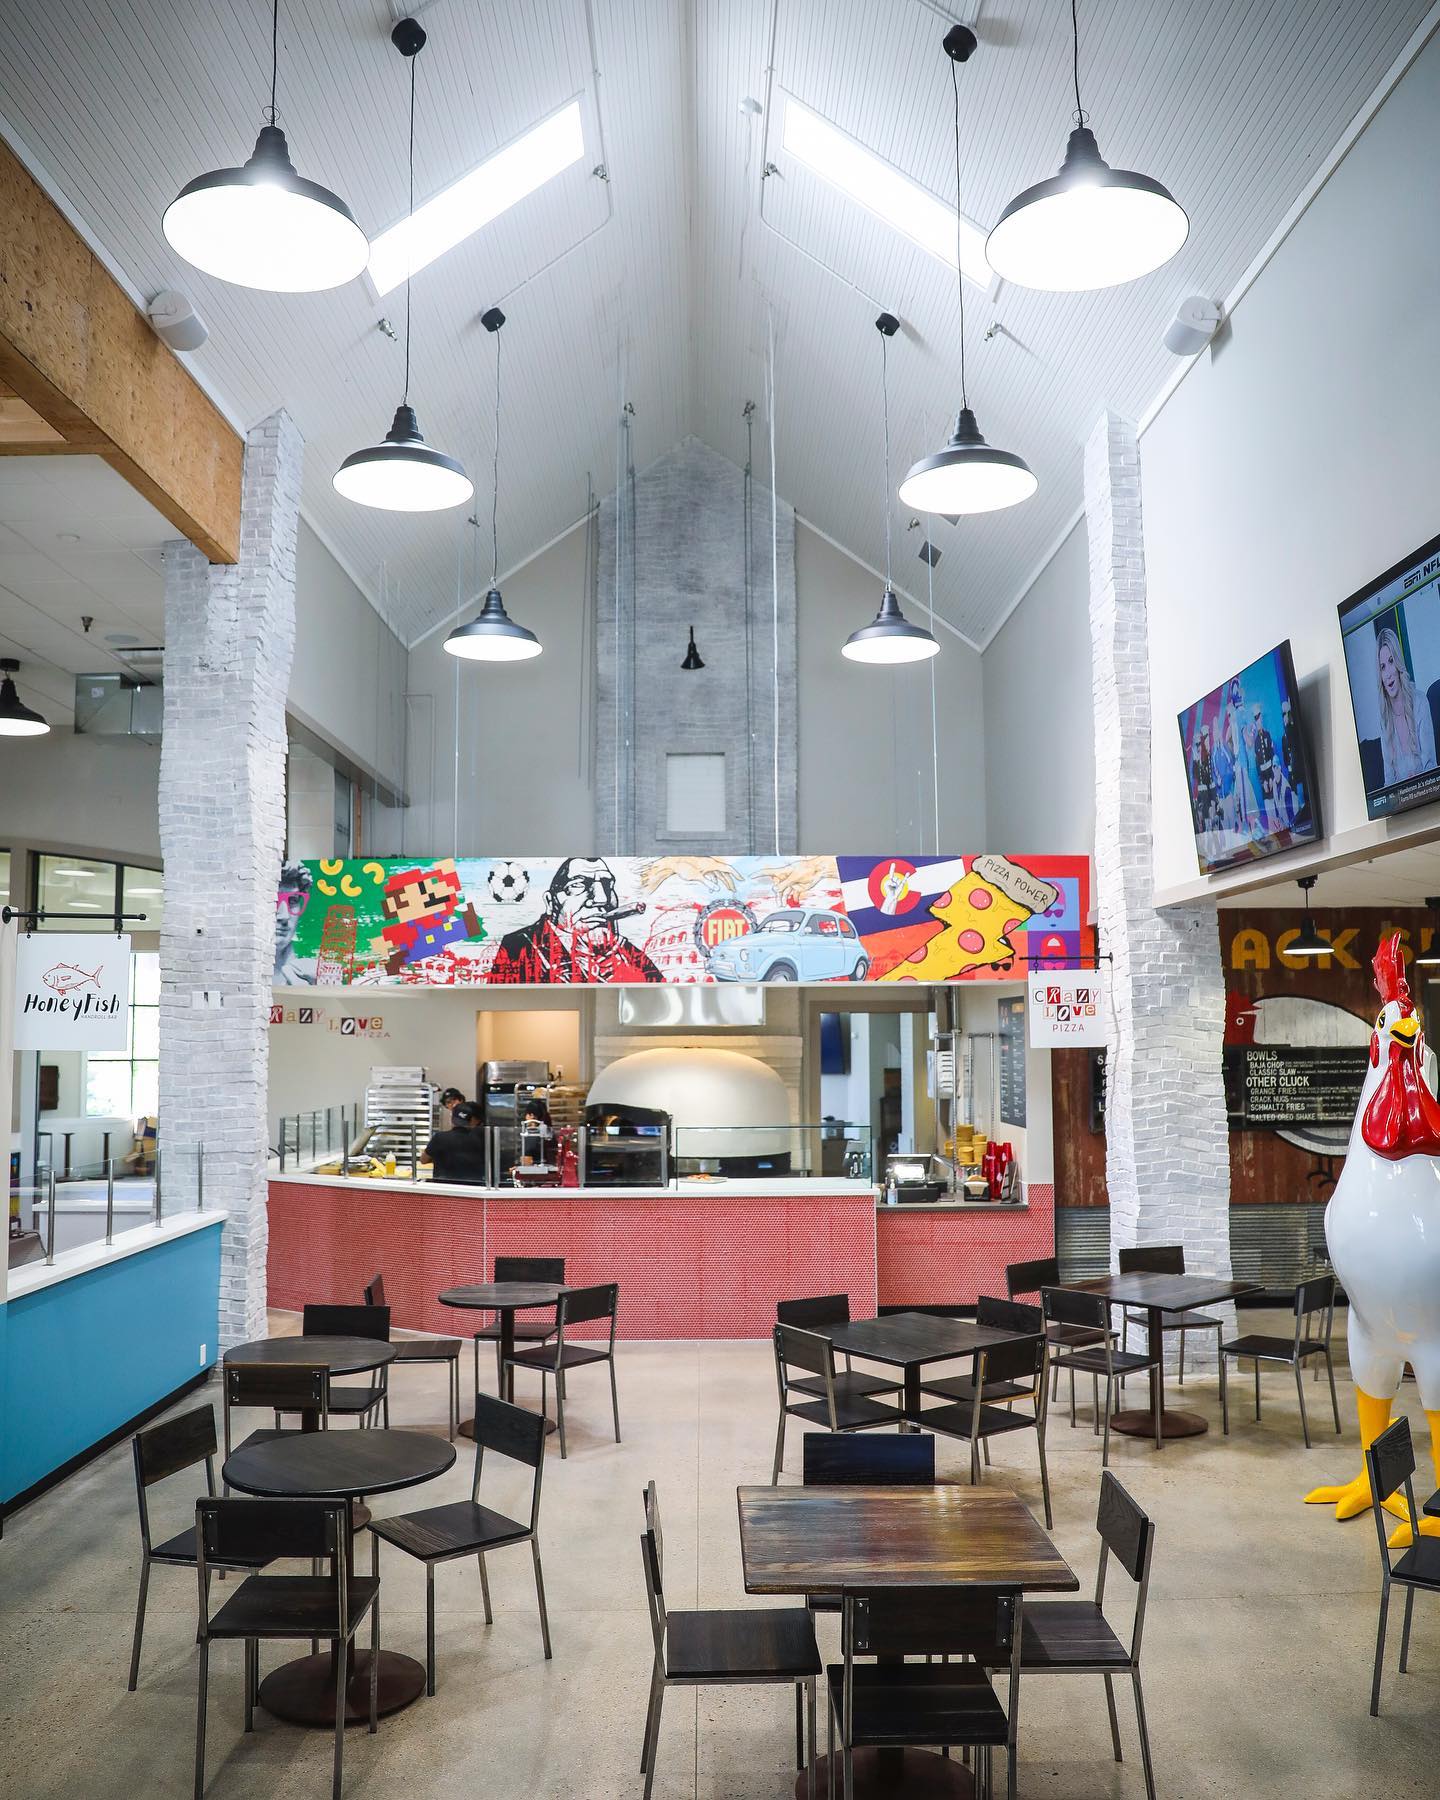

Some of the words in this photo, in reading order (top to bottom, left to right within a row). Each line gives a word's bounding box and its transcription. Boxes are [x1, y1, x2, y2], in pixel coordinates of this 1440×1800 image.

[1403, 570, 1421, 589] ESPN
[984, 858, 1009, 881] PIZZA
[1014, 876, 1048, 905] POWER
[708, 919, 746, 946] FIAT
[23, 993, 120, 1021] HoneyFish
[1052, 1023, 1085, 1032] PIZZA
[1246, 1050, 1278, 1061] BOWLS
[1249, 1061, 1266, 1069] BAJA
[1266, 1061, 1285, 1069] CHOP
[1279, 1068, 1296, 1076] SLAW
[1246, 1076, 1277, 1087] OTHER
[1279, 1076, 1310, 1087] CLUCK
[1278, 1087, 1297, 1095] FRIES
[1250, 1103, 1284, 1111] SCHMALTZ
[1286, 1103, 1305, 1111] FRIES
[1250, 1113, 1276, 1121] SALTED
